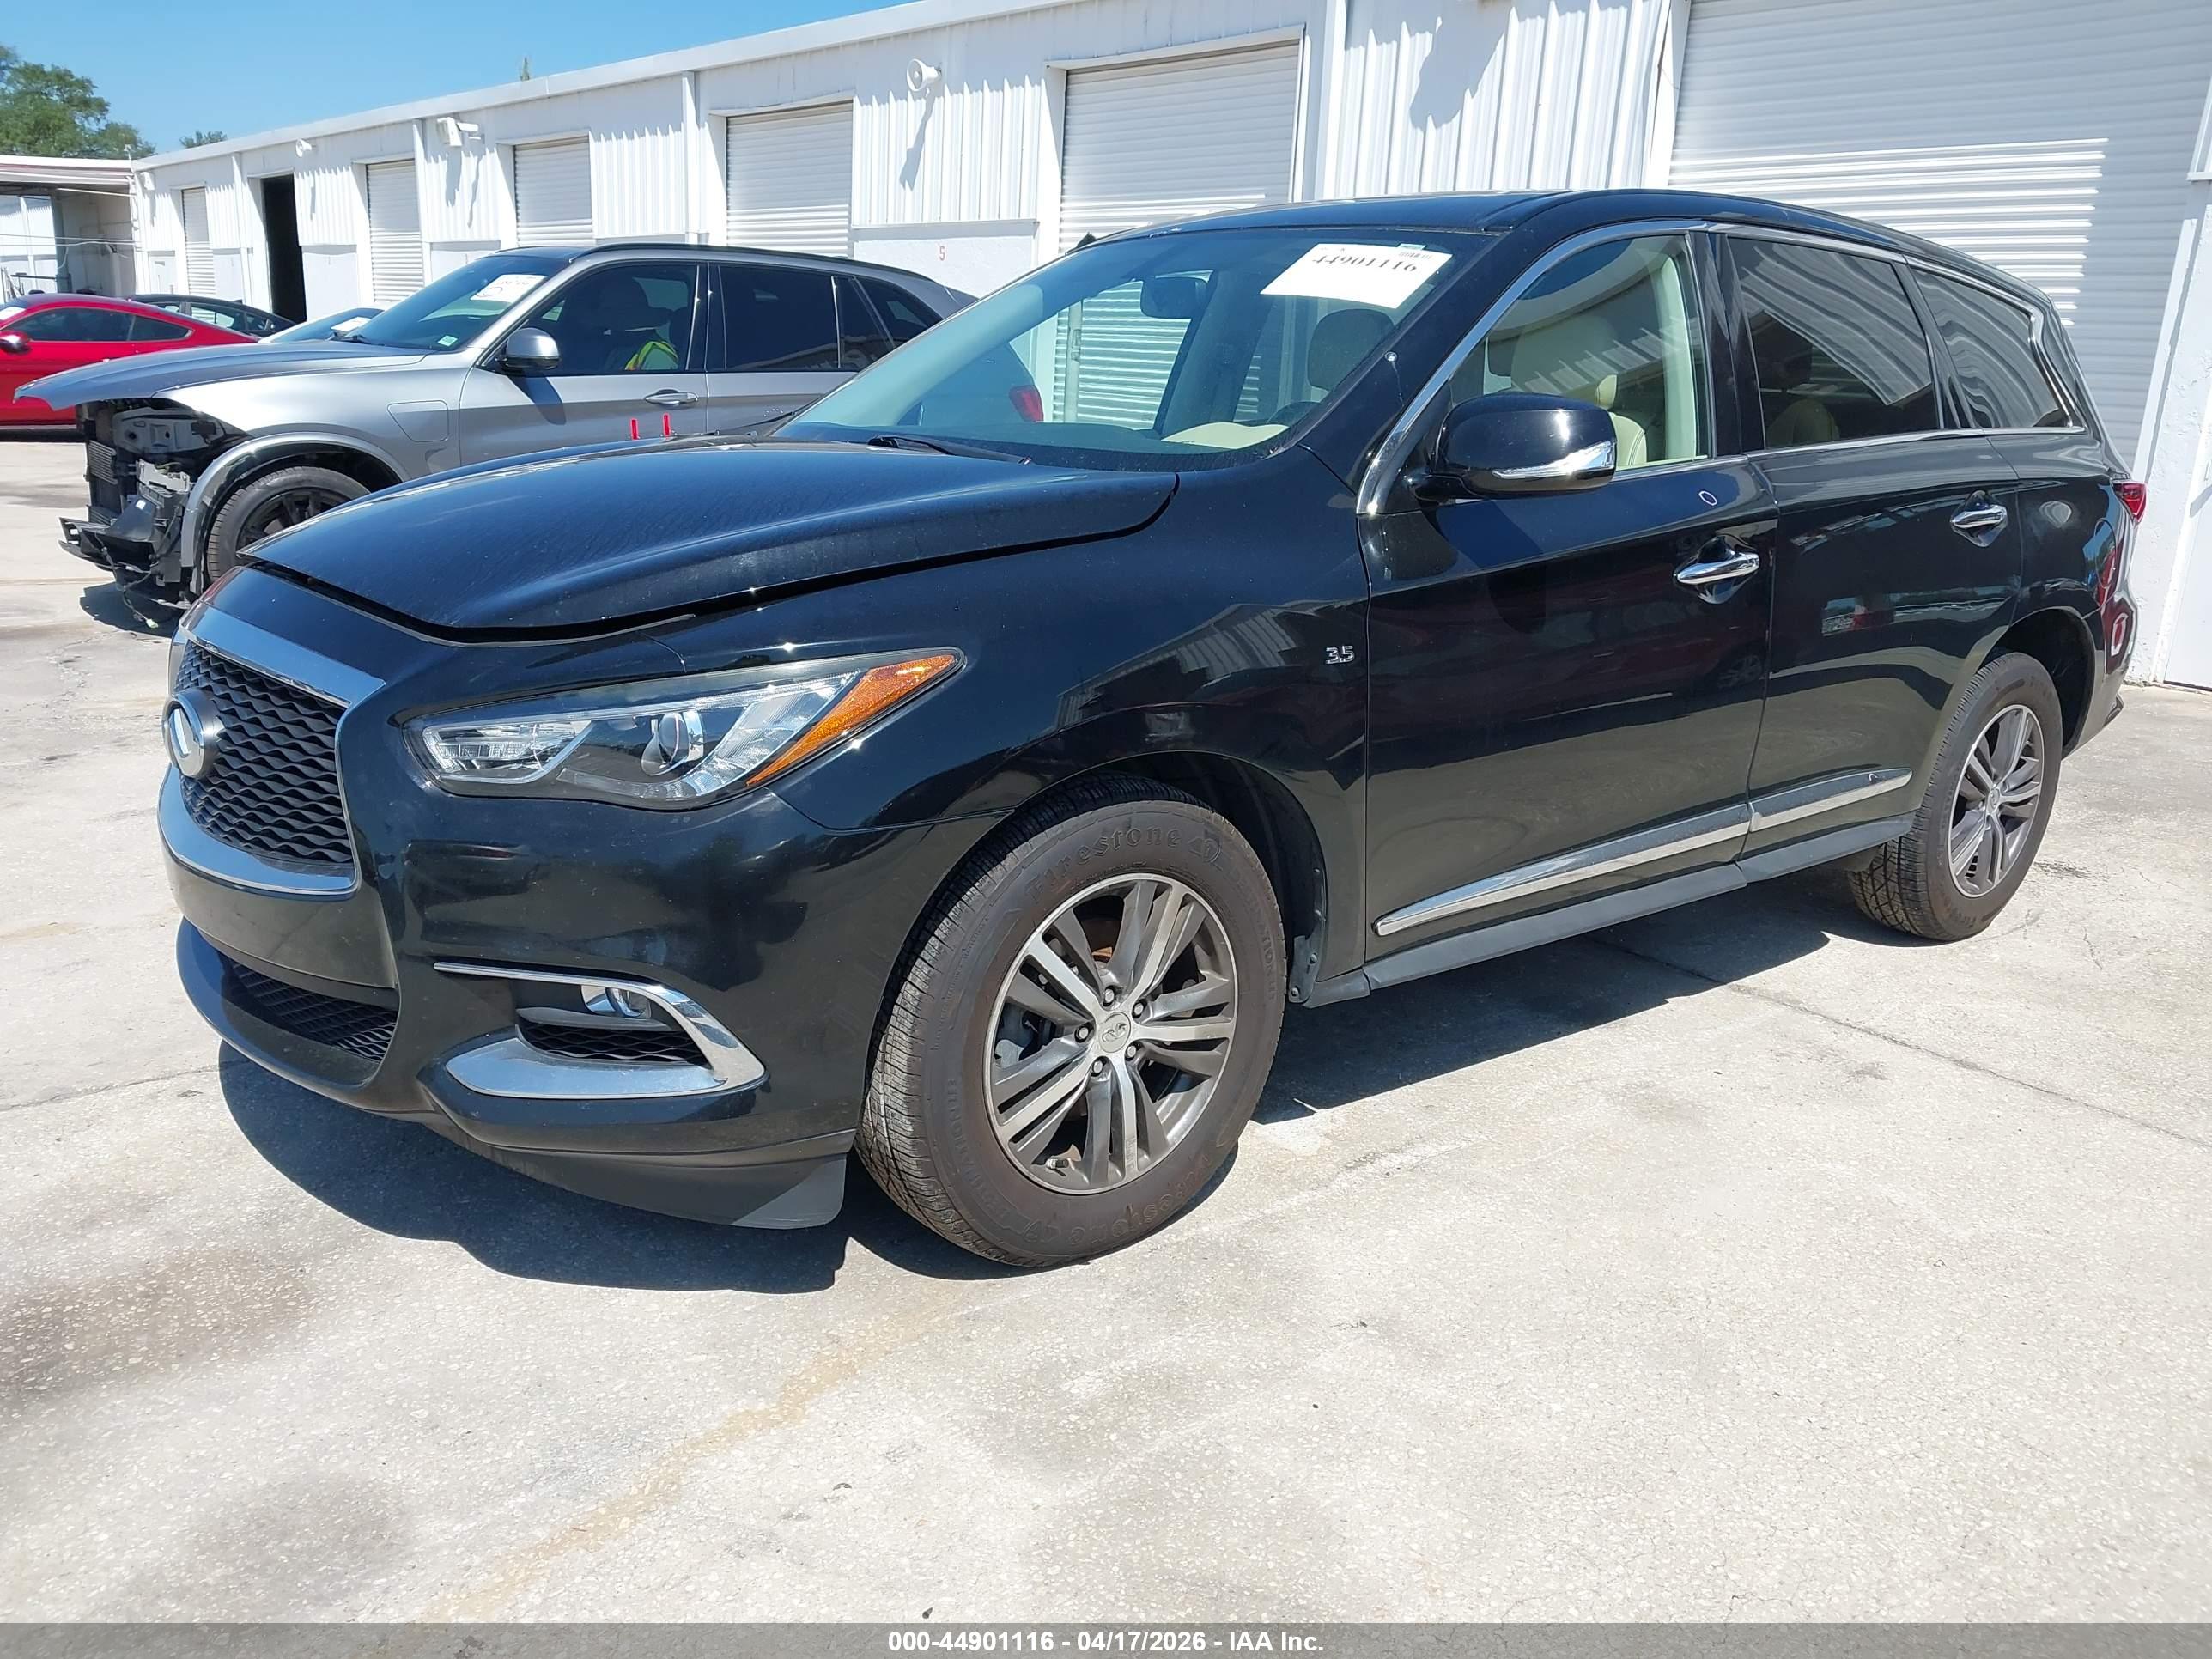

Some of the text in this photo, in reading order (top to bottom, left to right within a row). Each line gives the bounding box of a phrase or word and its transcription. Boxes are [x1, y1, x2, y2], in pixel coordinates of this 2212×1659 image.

[939, 246, 945, 261] 5
[1312, 255, 1417, 271] 44901116
[1025, 826, 1182, 899] Firestone
